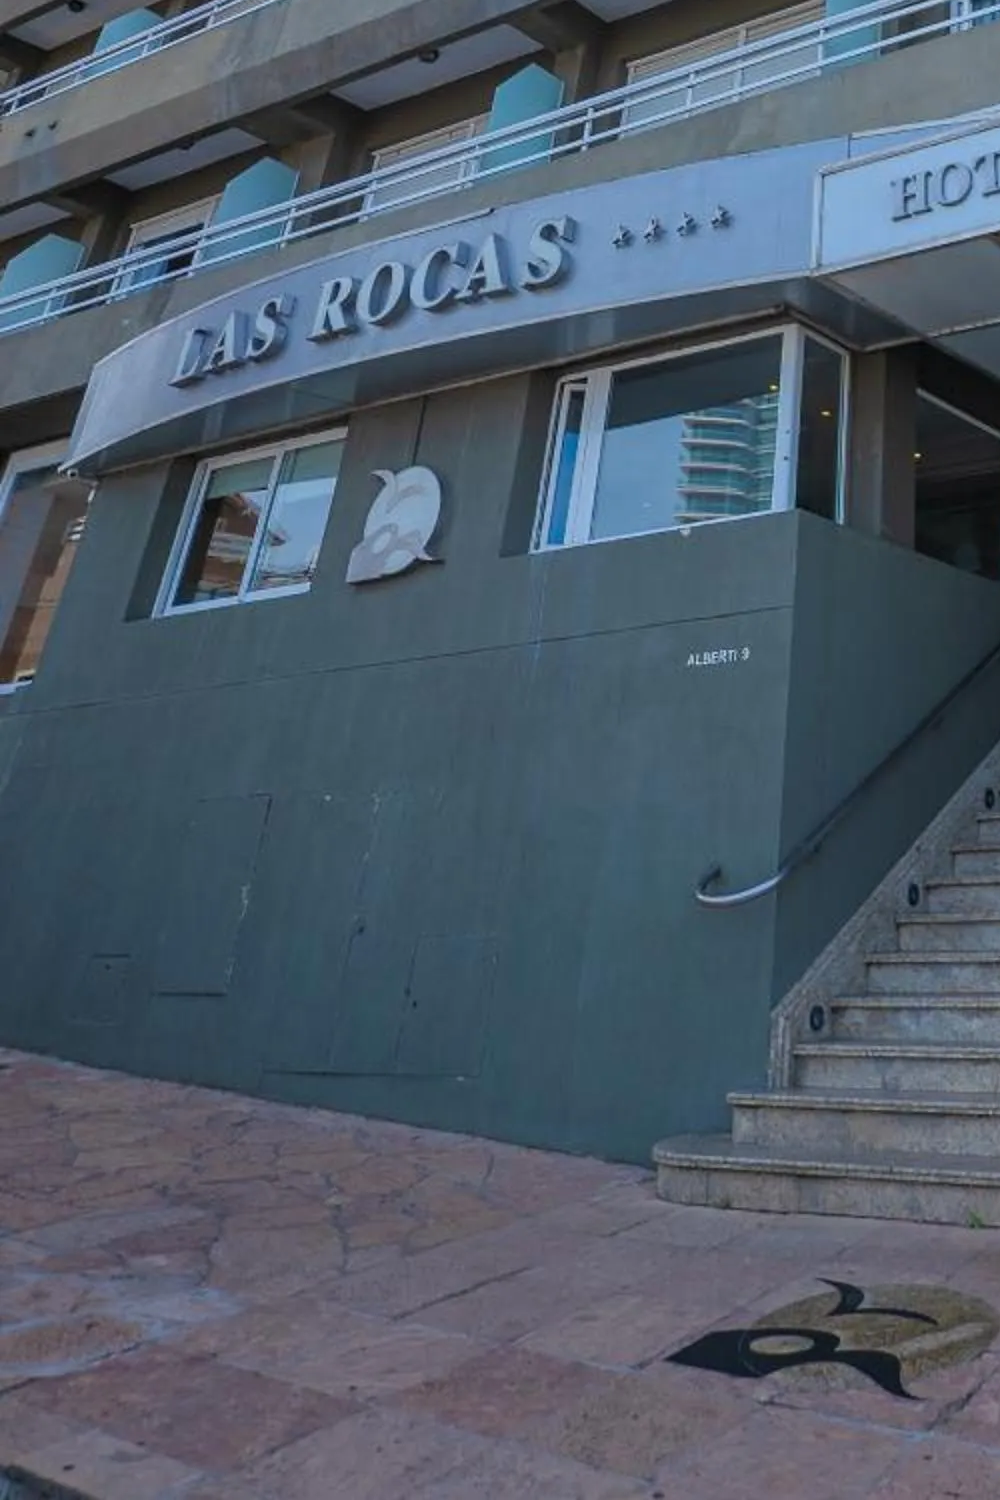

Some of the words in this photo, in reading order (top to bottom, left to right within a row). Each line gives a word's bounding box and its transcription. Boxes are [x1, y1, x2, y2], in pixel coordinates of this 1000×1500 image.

[169, 292, 297, 388] LAS
[307, 214, 577, 342] ROCAS
[687, 649, 737, 666] ALBERTI
